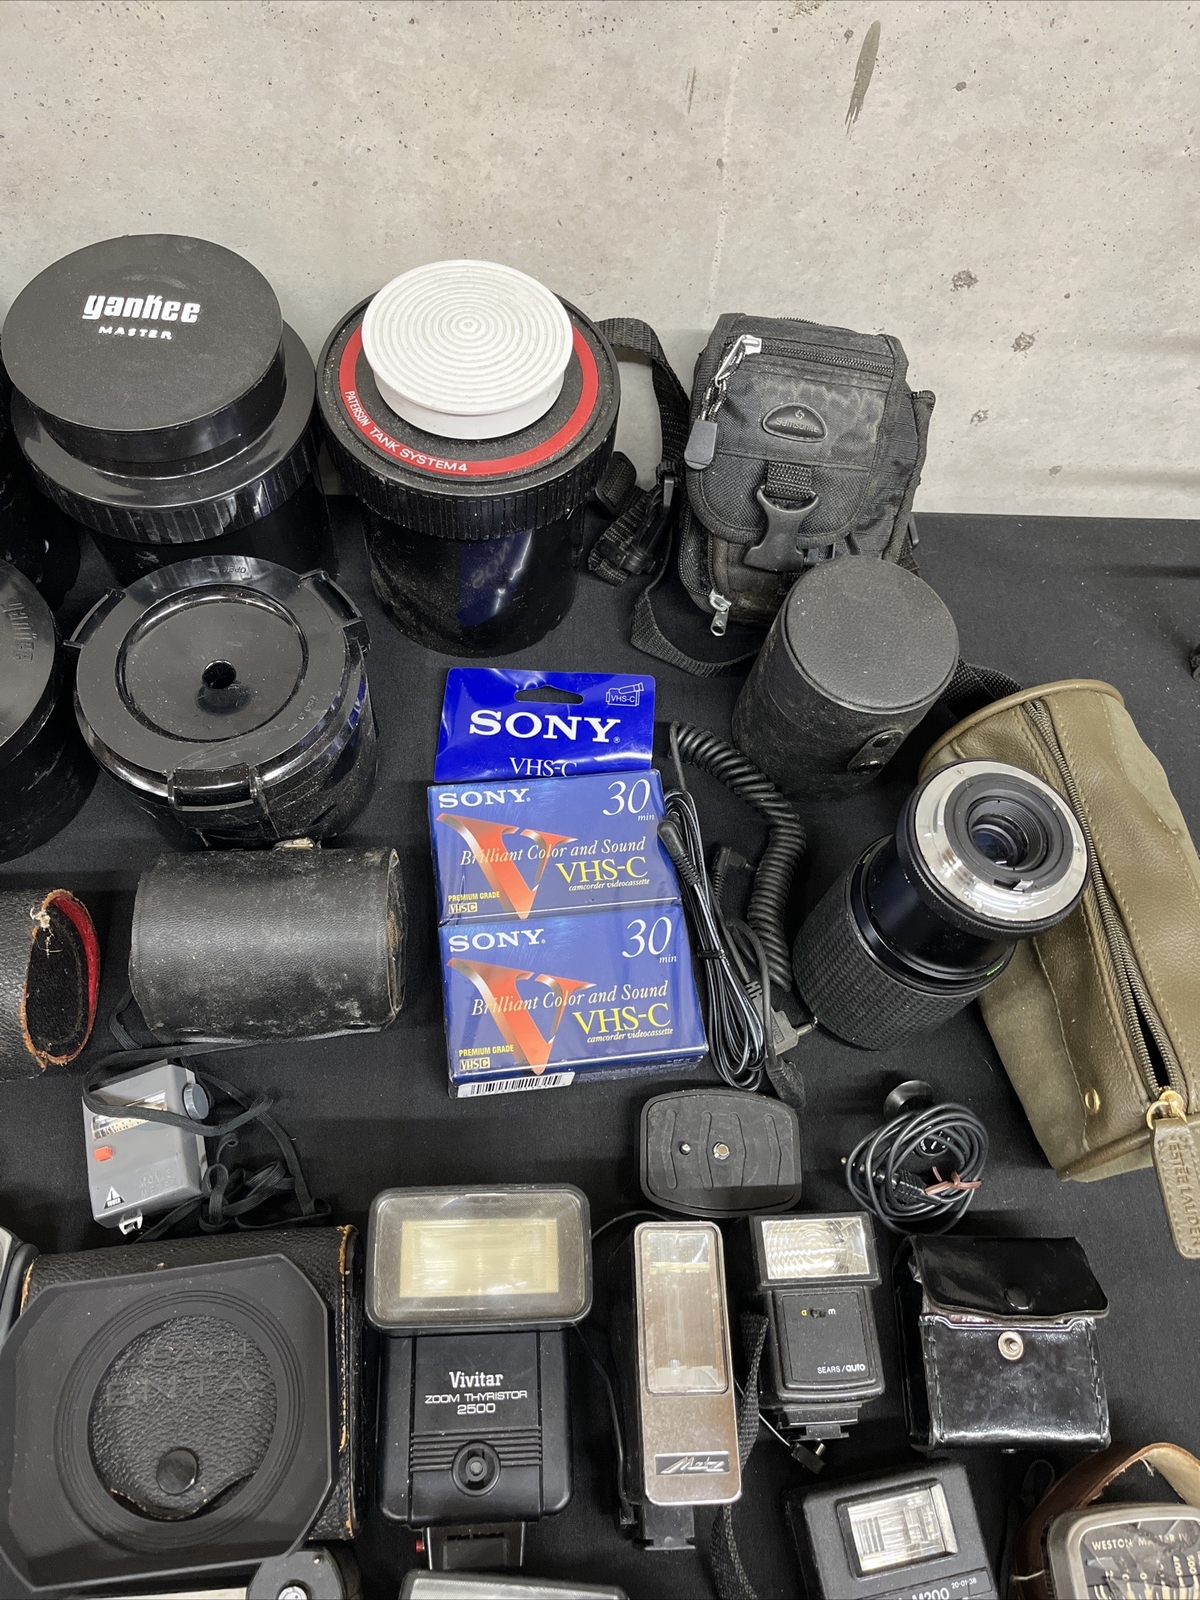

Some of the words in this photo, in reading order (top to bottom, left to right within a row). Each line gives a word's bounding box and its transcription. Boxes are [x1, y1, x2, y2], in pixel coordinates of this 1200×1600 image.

[82, 294, 200, 323] yankee
[98, 326, 172, 340] MASTER
[345, 390, 371, 427] PATERSON
[369, 426, 400, 452] TANK
[775, 416, 820, 433] Samsonite
[611, 695, 636, 703] VHS-C
[469, 710, 621, 743] SONY
[509, 757, 577, 777] VHS-C
[438, 788, 530, 809] SONY
[602, 779, 651, 816] 30
[637, 813, 655, 822] min
[460, 846, 523, 866] Brilliant
[527, 843, 567, 859] Color
[571, 839, 599, 857] and
[601, 836, 646, 854] Sound
[555, 856, 649, 884] VHS-C
[568, 881, 605, 892] camcorder
[606, 878, 651, 889] videocassette
[448, 892, 479, 902] PREMIUM
[479, 891, 501, 900] GRADE
[448, 928, 545, 953] SONY
[622, 916, 672, 958] 30
[659, 954, 678, 964] min
[471, 993, 538, 1016] Brilliant
[543, 989, 582, 1009] Color
[588, 985, 617, 1003] and
[621, 980, 668, 1000] Sound
[572, 1003, 671, 1035] VHS-C
[587, 1032, 626, 1043] camcorder
[627, 1028, 674, 1039] videocassette
[459, 1046, 491, 1057] PREMIUM
[492, 1044, 514, 1054] GRADE
[449, 1371, 503, 1388] Vivitar
[425, 1394, 460, 1404] ZOOM
[464, 1390, 528, 1402] THYRISTOR
[457, 1403, 496, 1415] 2500
[660, 1456, 725, 1474] Metz
[1092, 1538, 1133, 1551] WESTON
